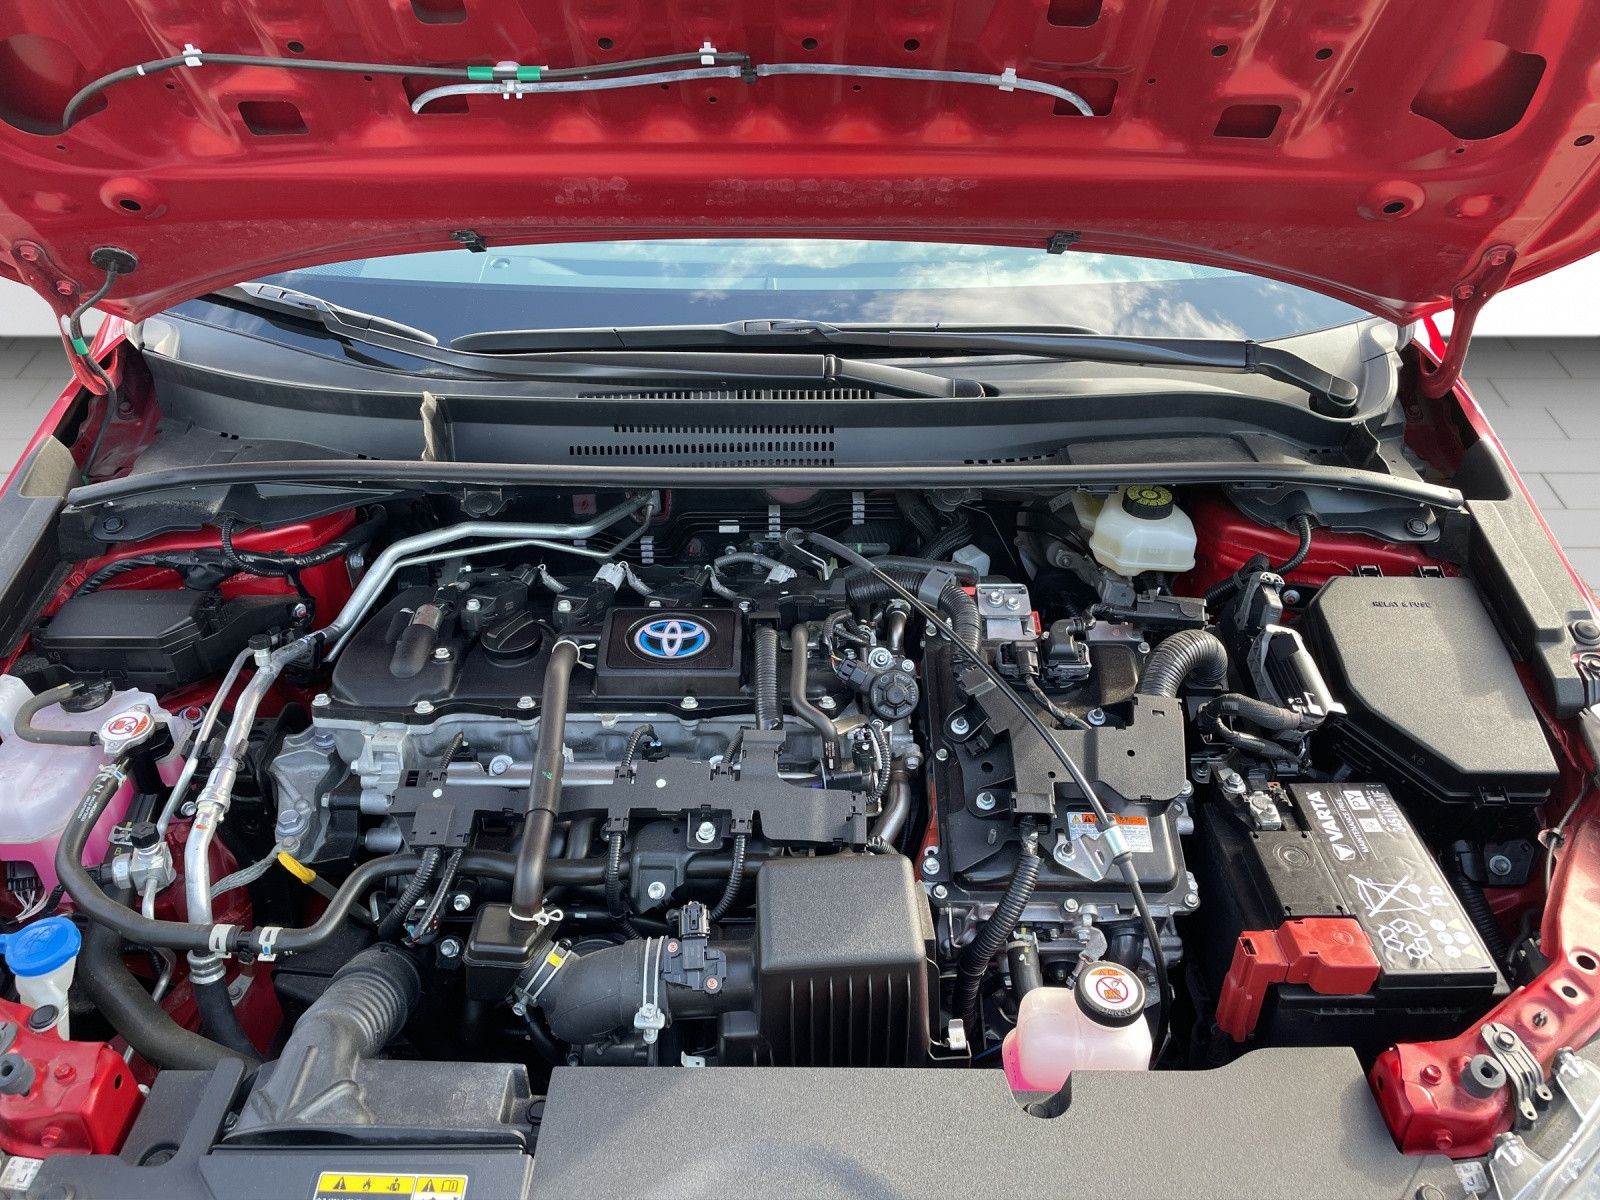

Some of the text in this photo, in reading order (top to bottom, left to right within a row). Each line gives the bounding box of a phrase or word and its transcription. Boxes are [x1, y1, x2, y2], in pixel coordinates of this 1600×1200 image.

[1305, 791, 1344, 842] VARTA
[1346, 792, 1367, 808] PY
[1334, 798, 1370, 853] MAINTENANCE FREE
[1427, 885, 1450, 907] Pb
